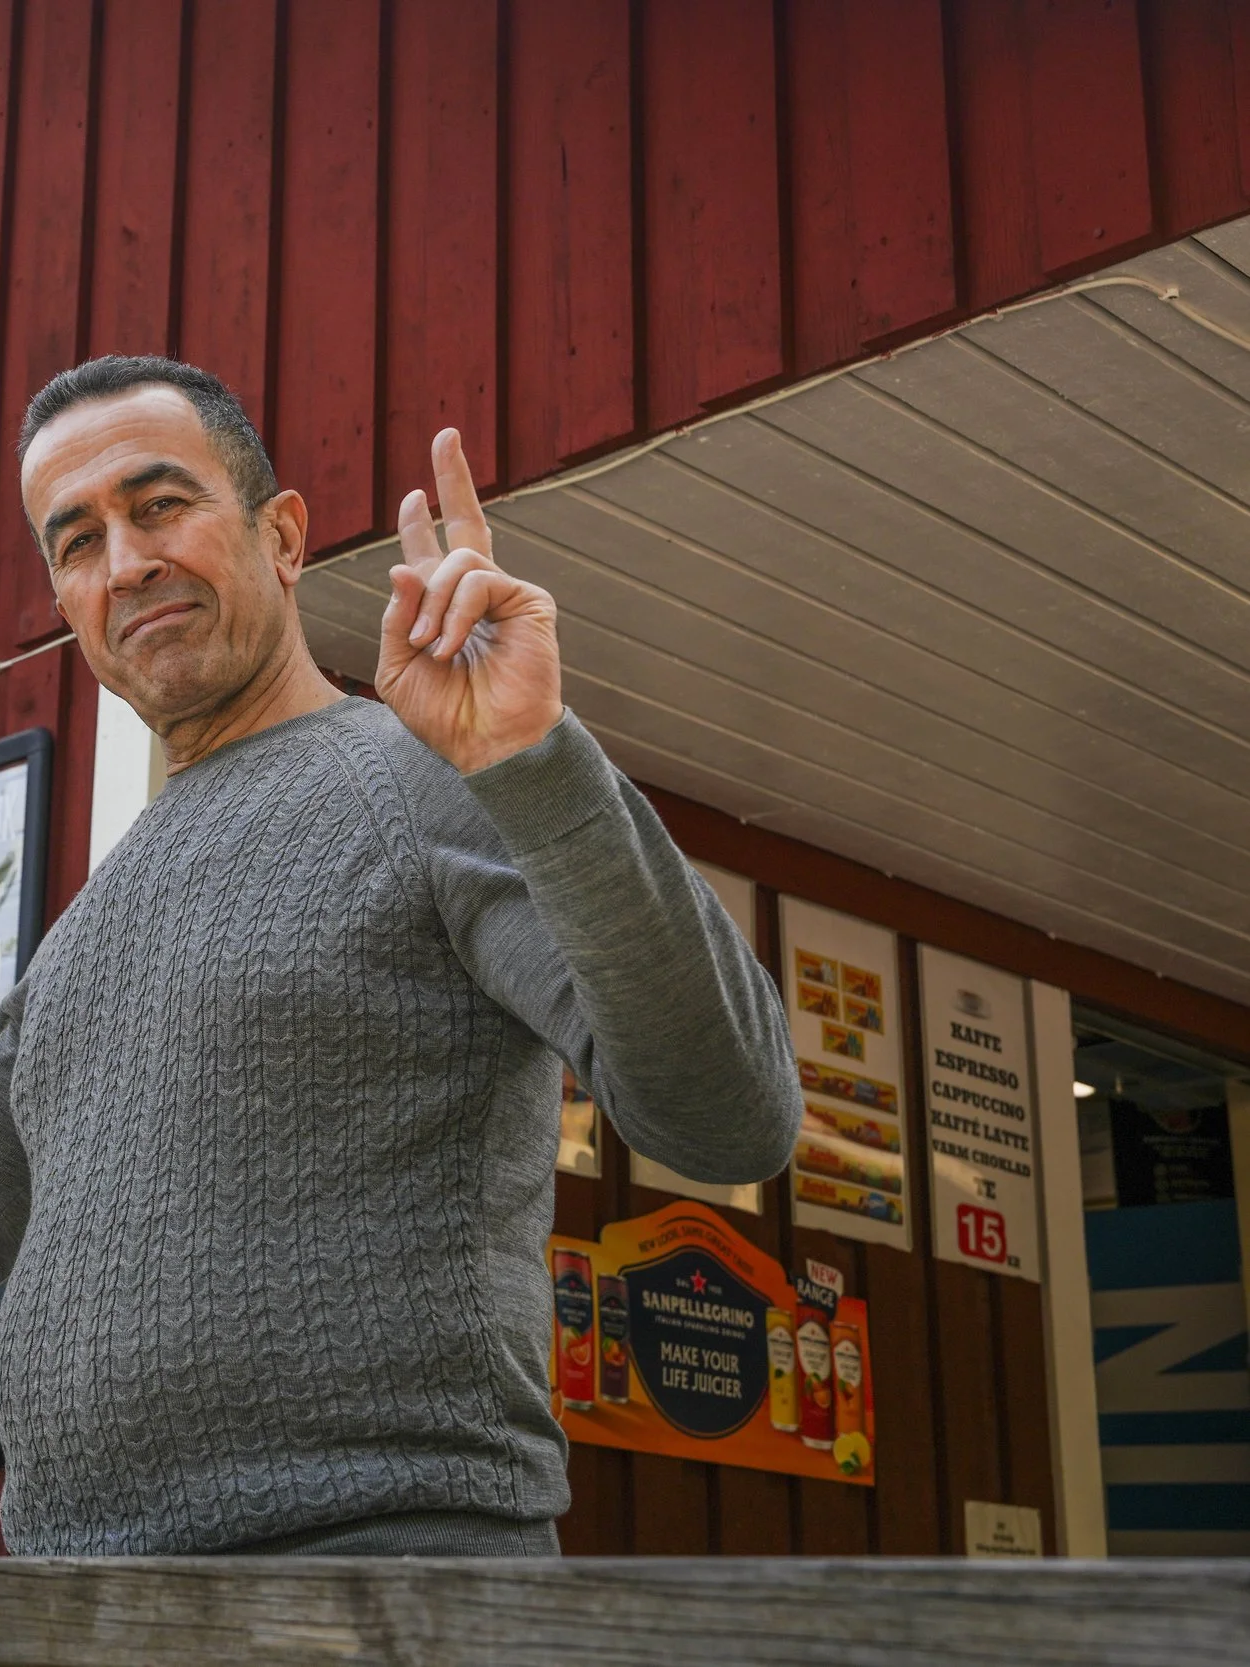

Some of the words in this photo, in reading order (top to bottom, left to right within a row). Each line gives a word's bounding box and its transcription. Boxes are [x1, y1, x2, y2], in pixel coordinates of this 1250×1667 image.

[950, 1021, 1002, 1055] KAFFE
[934, 1048, 1019, 1091] ESPRESSO
[932, 1079, 1025, 1122] CAPPUCCINO
[983, 1123, 1029, 1153] LATTE
[932, 1140, 969, 1162] VARM
[972, 1149, 1031, 1178] CHOKLAD
[972, 1175, 997, 1200] TE
[960, 1211, 1002, 1258] 15
[810, 1262, 838, 1287] NEW
[642, 1289, 755, 1329] SANPELLEGRINO
[796, 1277, 835, 1309] RANGE
[660, 1341, 699, 1367] MAKE
[702, 1348, 740, 1374] YOUR
[662, 1366, 689, 1390] LIFE
[691, 1371, 743, 1400] JUICIER
